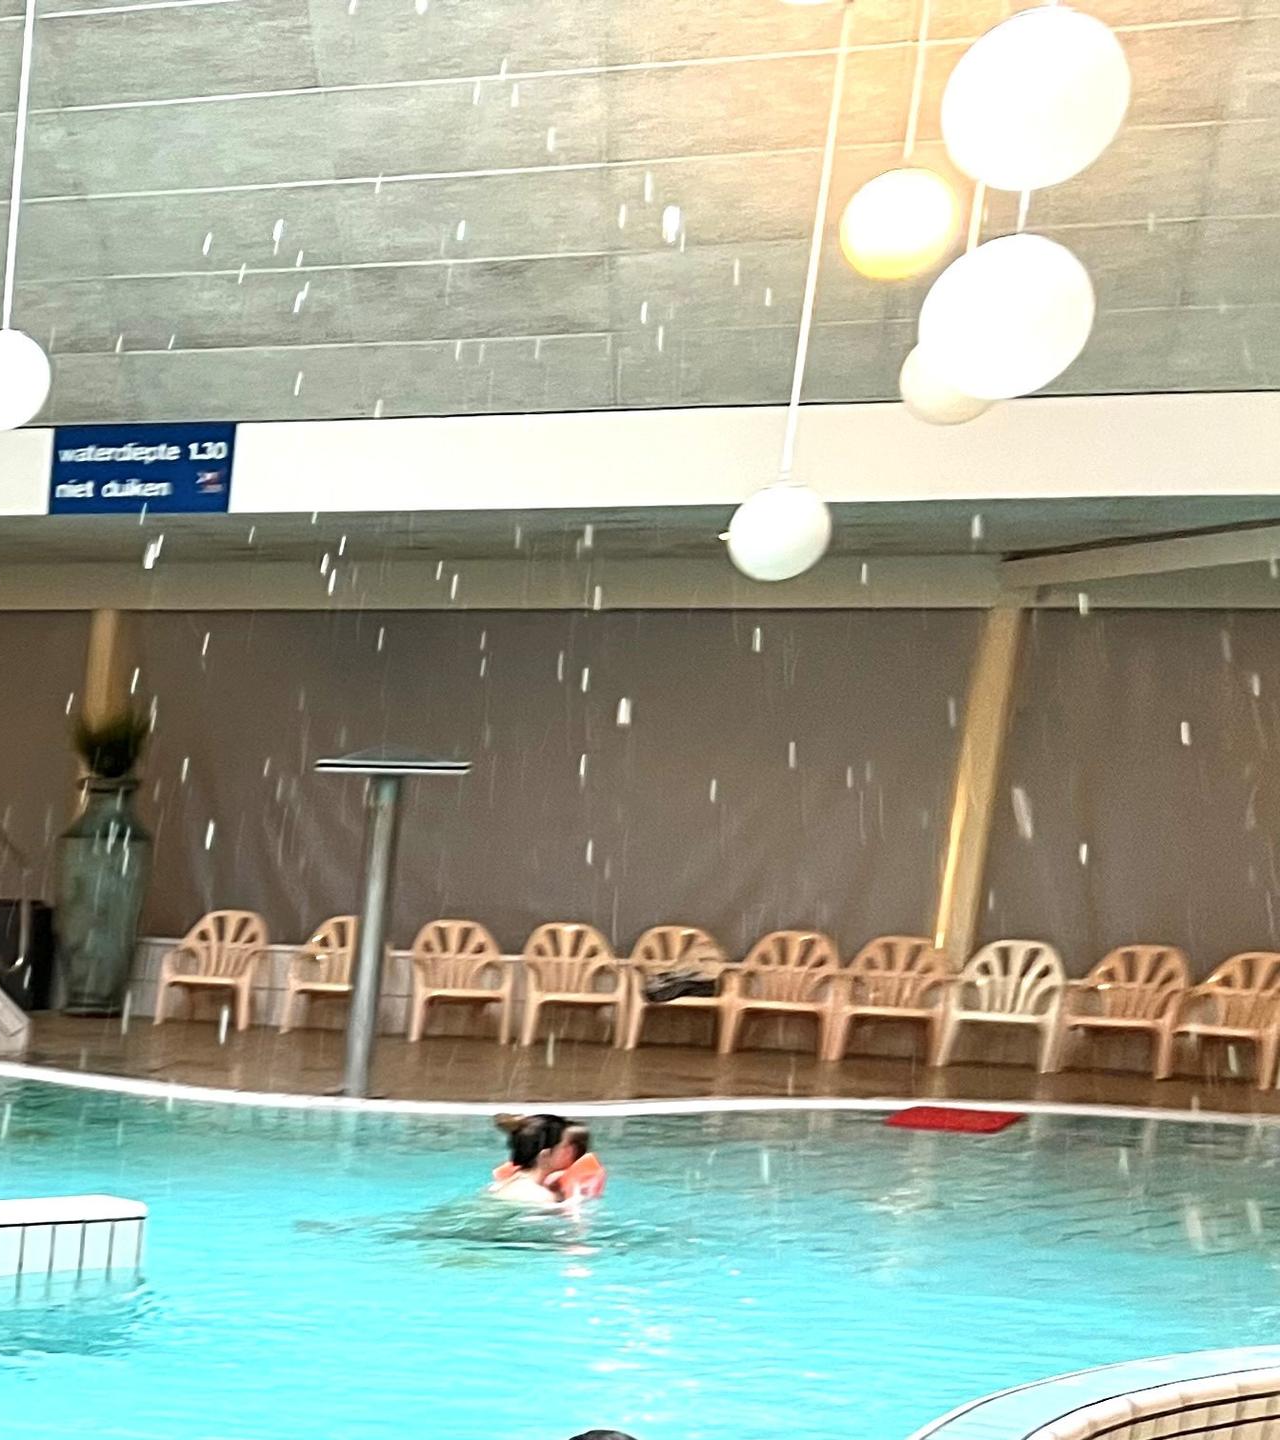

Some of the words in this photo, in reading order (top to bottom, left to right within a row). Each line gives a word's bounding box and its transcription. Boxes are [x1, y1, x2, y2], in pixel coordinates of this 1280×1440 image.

[57, 442, 181, 465] waterdiepte
[55, 479, 95, 498] niet
[101, 478, 173, 497] duiken
